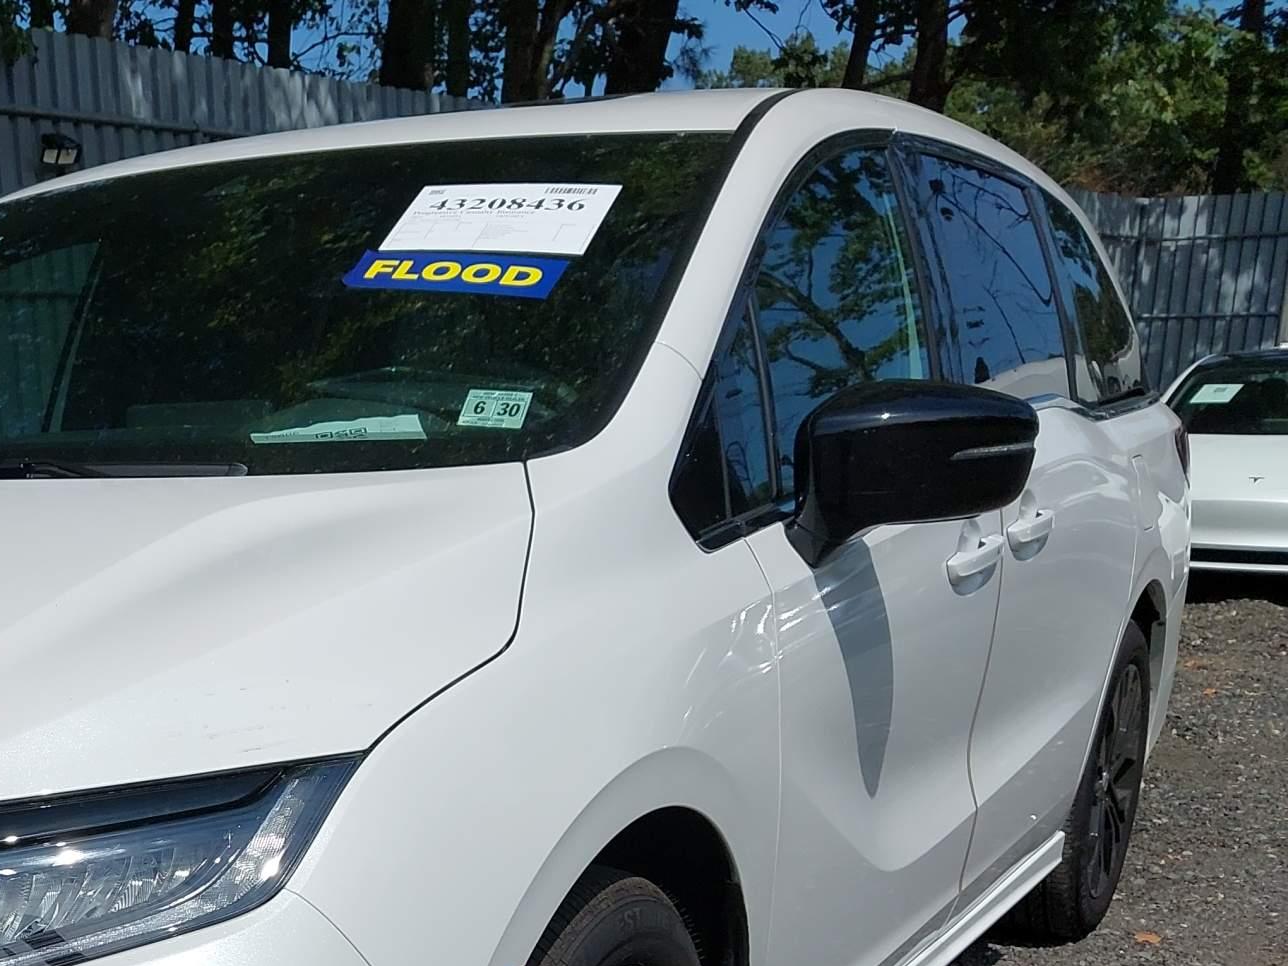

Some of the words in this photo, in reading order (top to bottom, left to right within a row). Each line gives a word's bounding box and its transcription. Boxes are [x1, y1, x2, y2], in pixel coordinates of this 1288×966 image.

[429, 198, 587, 211] 43208436
[362, 260, 544, 287] FLOOD
[473, 400, 487, 415] 6
[497, 402, 521, 417] 30
